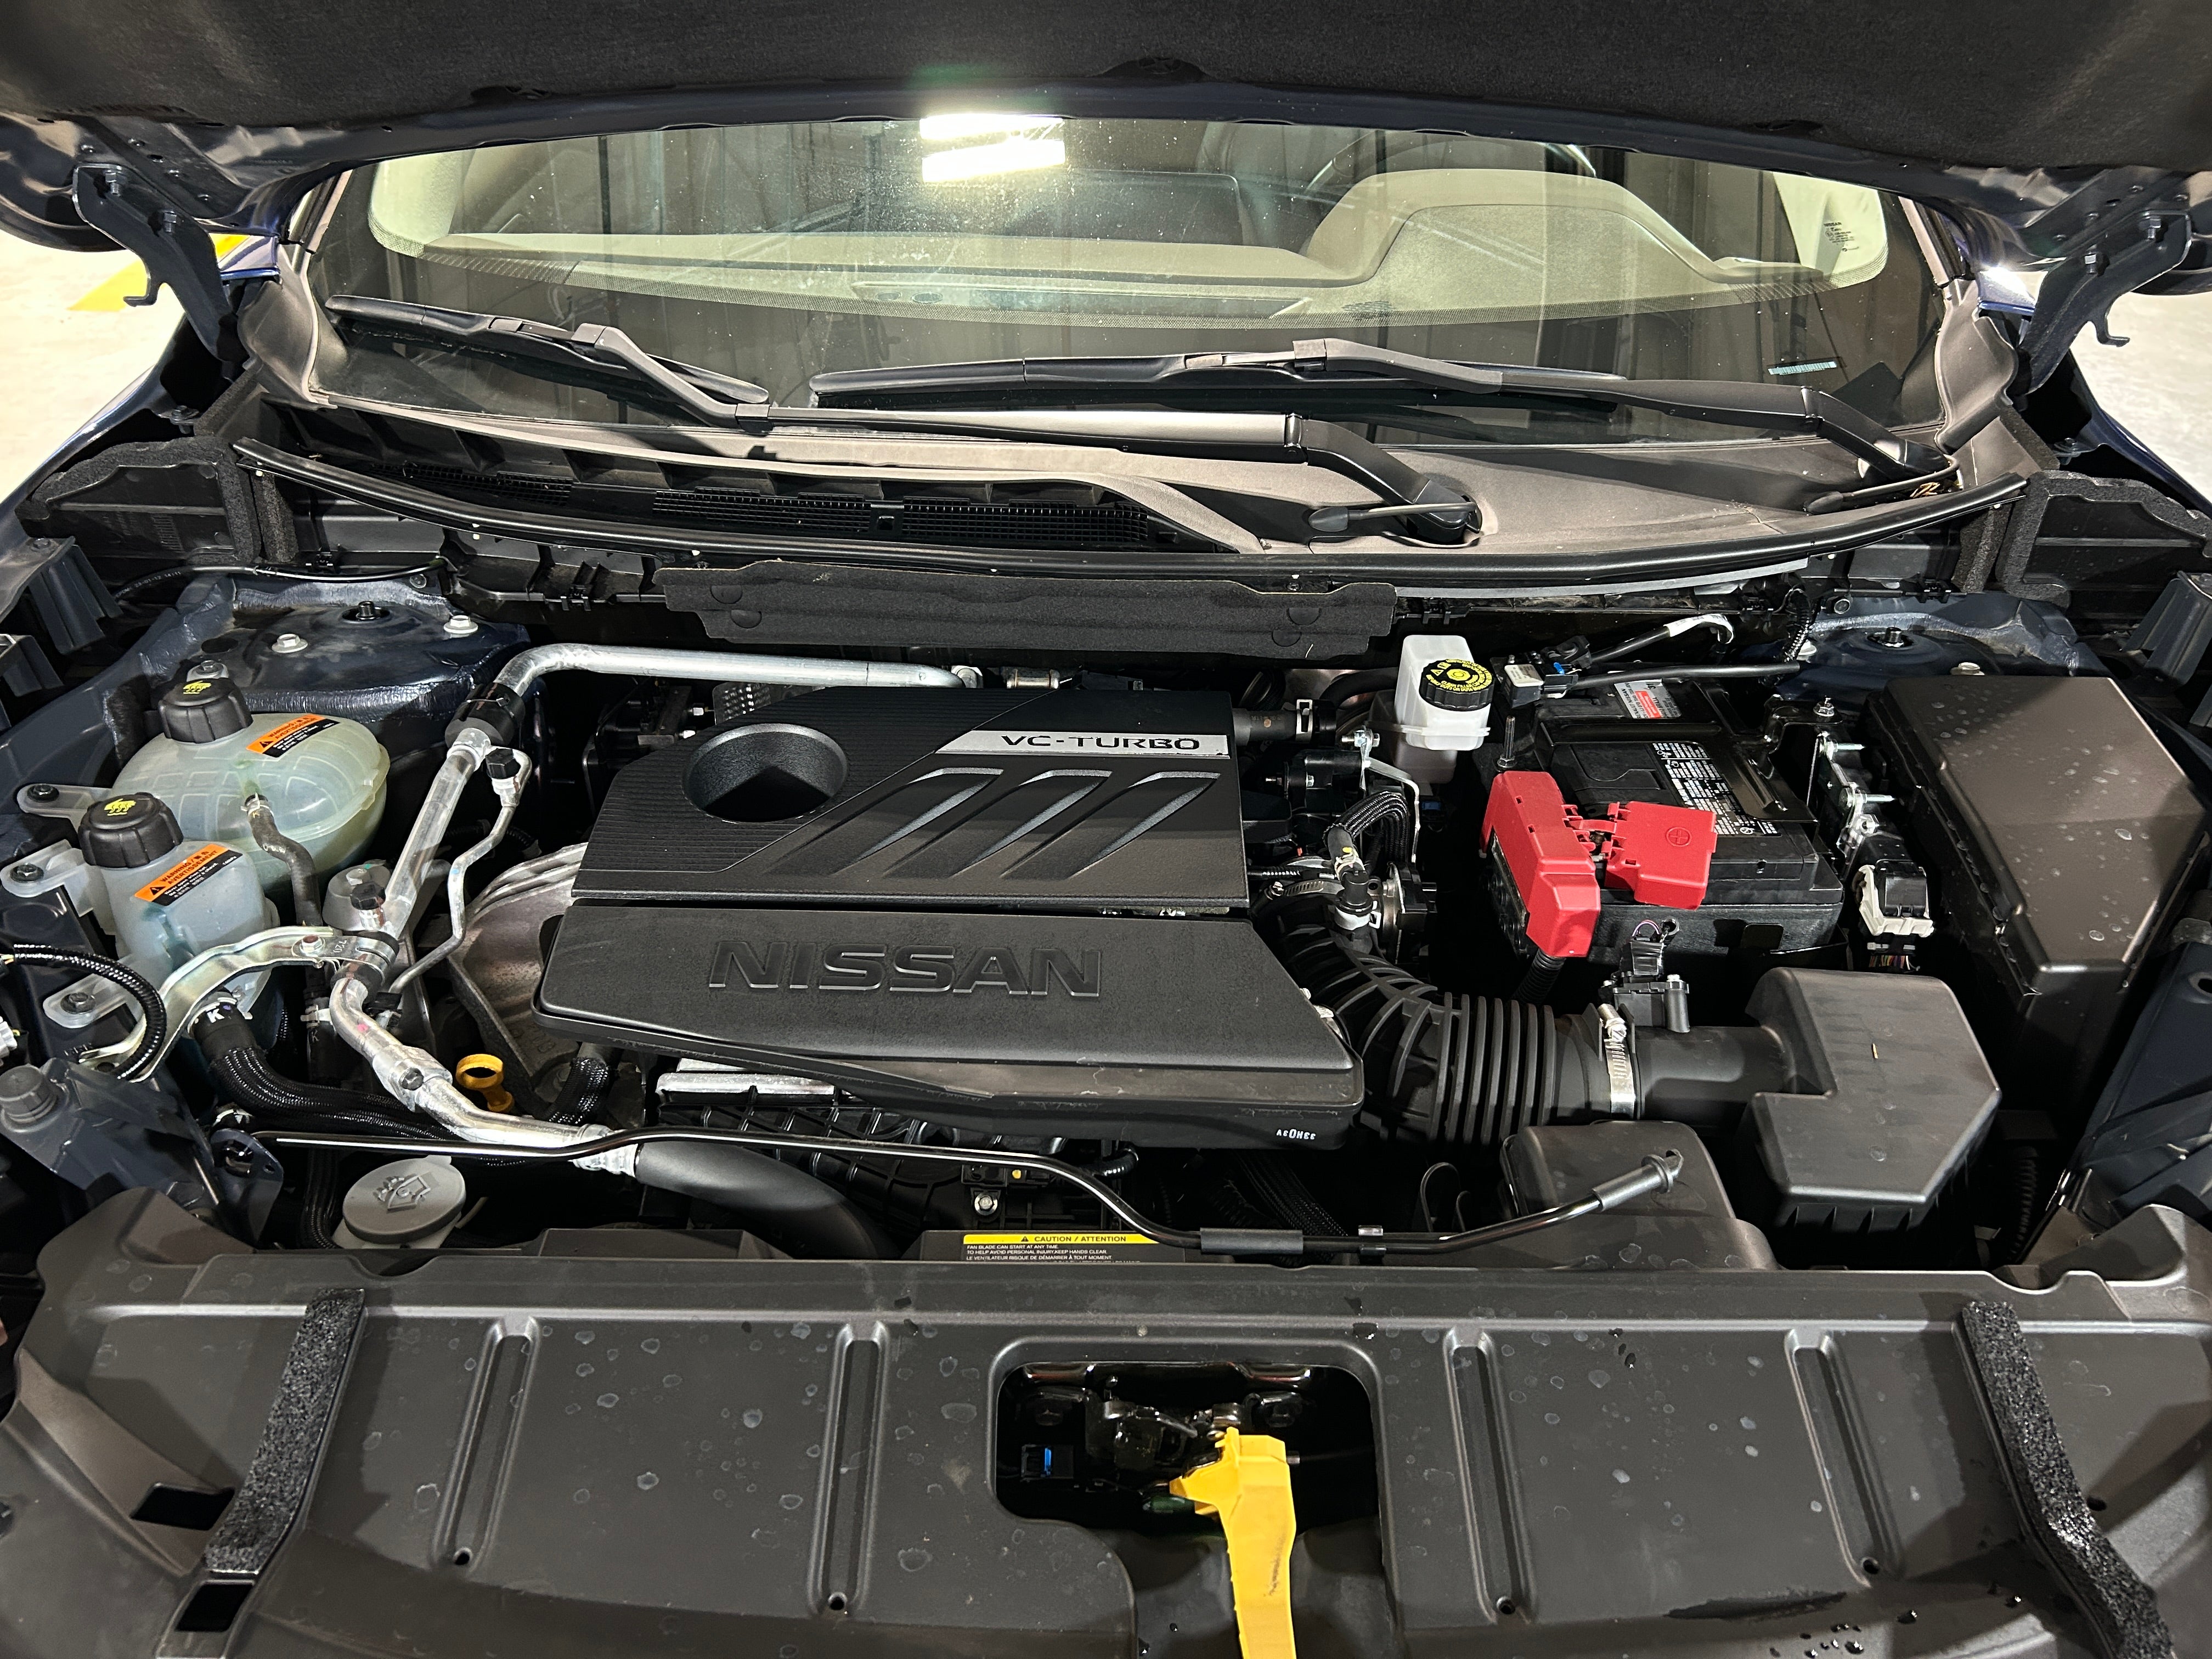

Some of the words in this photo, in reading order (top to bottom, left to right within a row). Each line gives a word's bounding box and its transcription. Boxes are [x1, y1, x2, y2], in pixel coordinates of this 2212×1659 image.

[1000, 735, 1200, 751] VC-TURBO
[160, 862, 191, 882] WARNING
[167, 850, 218, 884] AVERTISSEMENT
[709, 941, 1101, 996] NISSAN
[207, 1008, 225, 1023] K
